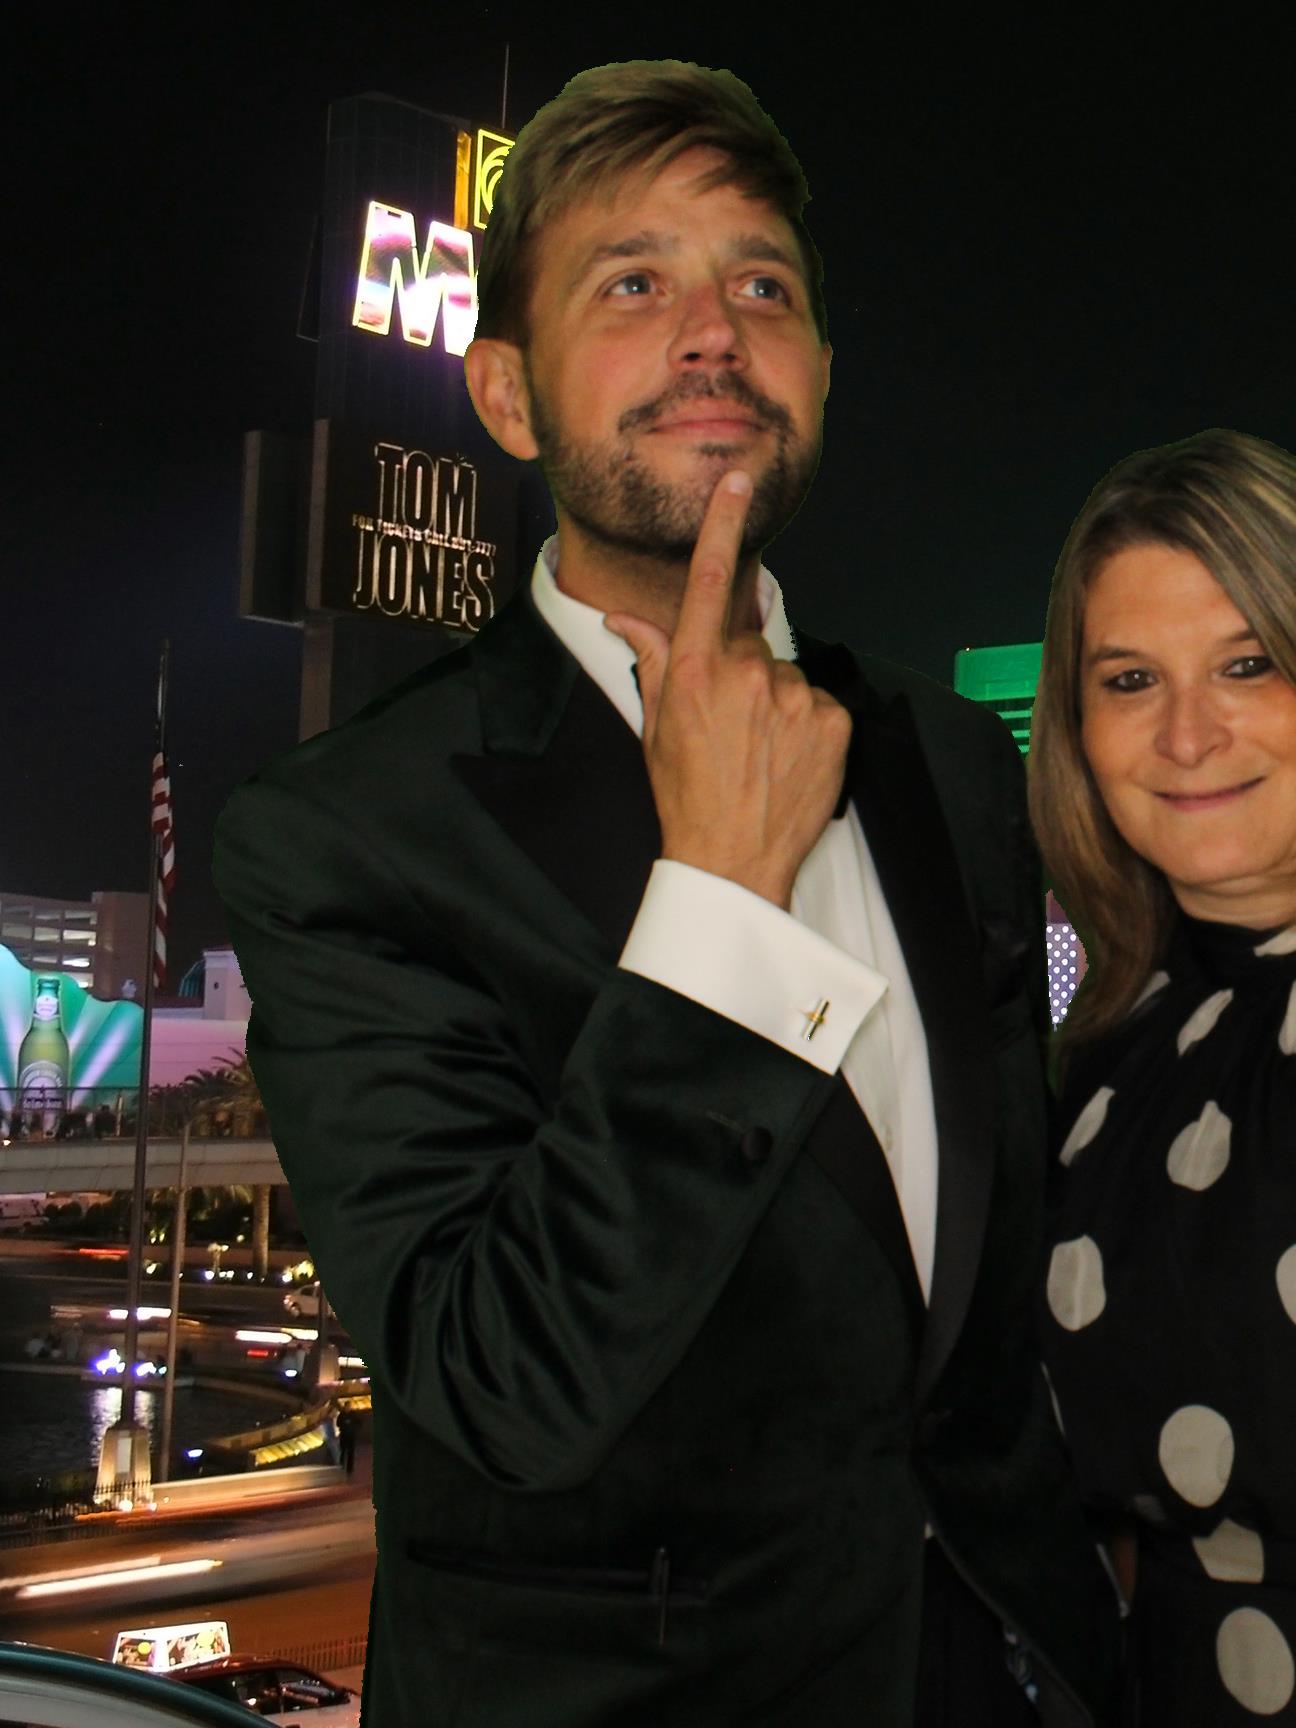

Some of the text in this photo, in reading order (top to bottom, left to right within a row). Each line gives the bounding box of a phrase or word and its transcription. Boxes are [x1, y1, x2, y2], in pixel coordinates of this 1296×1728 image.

[352, 513, 374, 531] FOR
[376, 518, 422, 541] TICKETS
[375, 441, 477, 540] TOM
[353, 531, 495, 632] JONES
